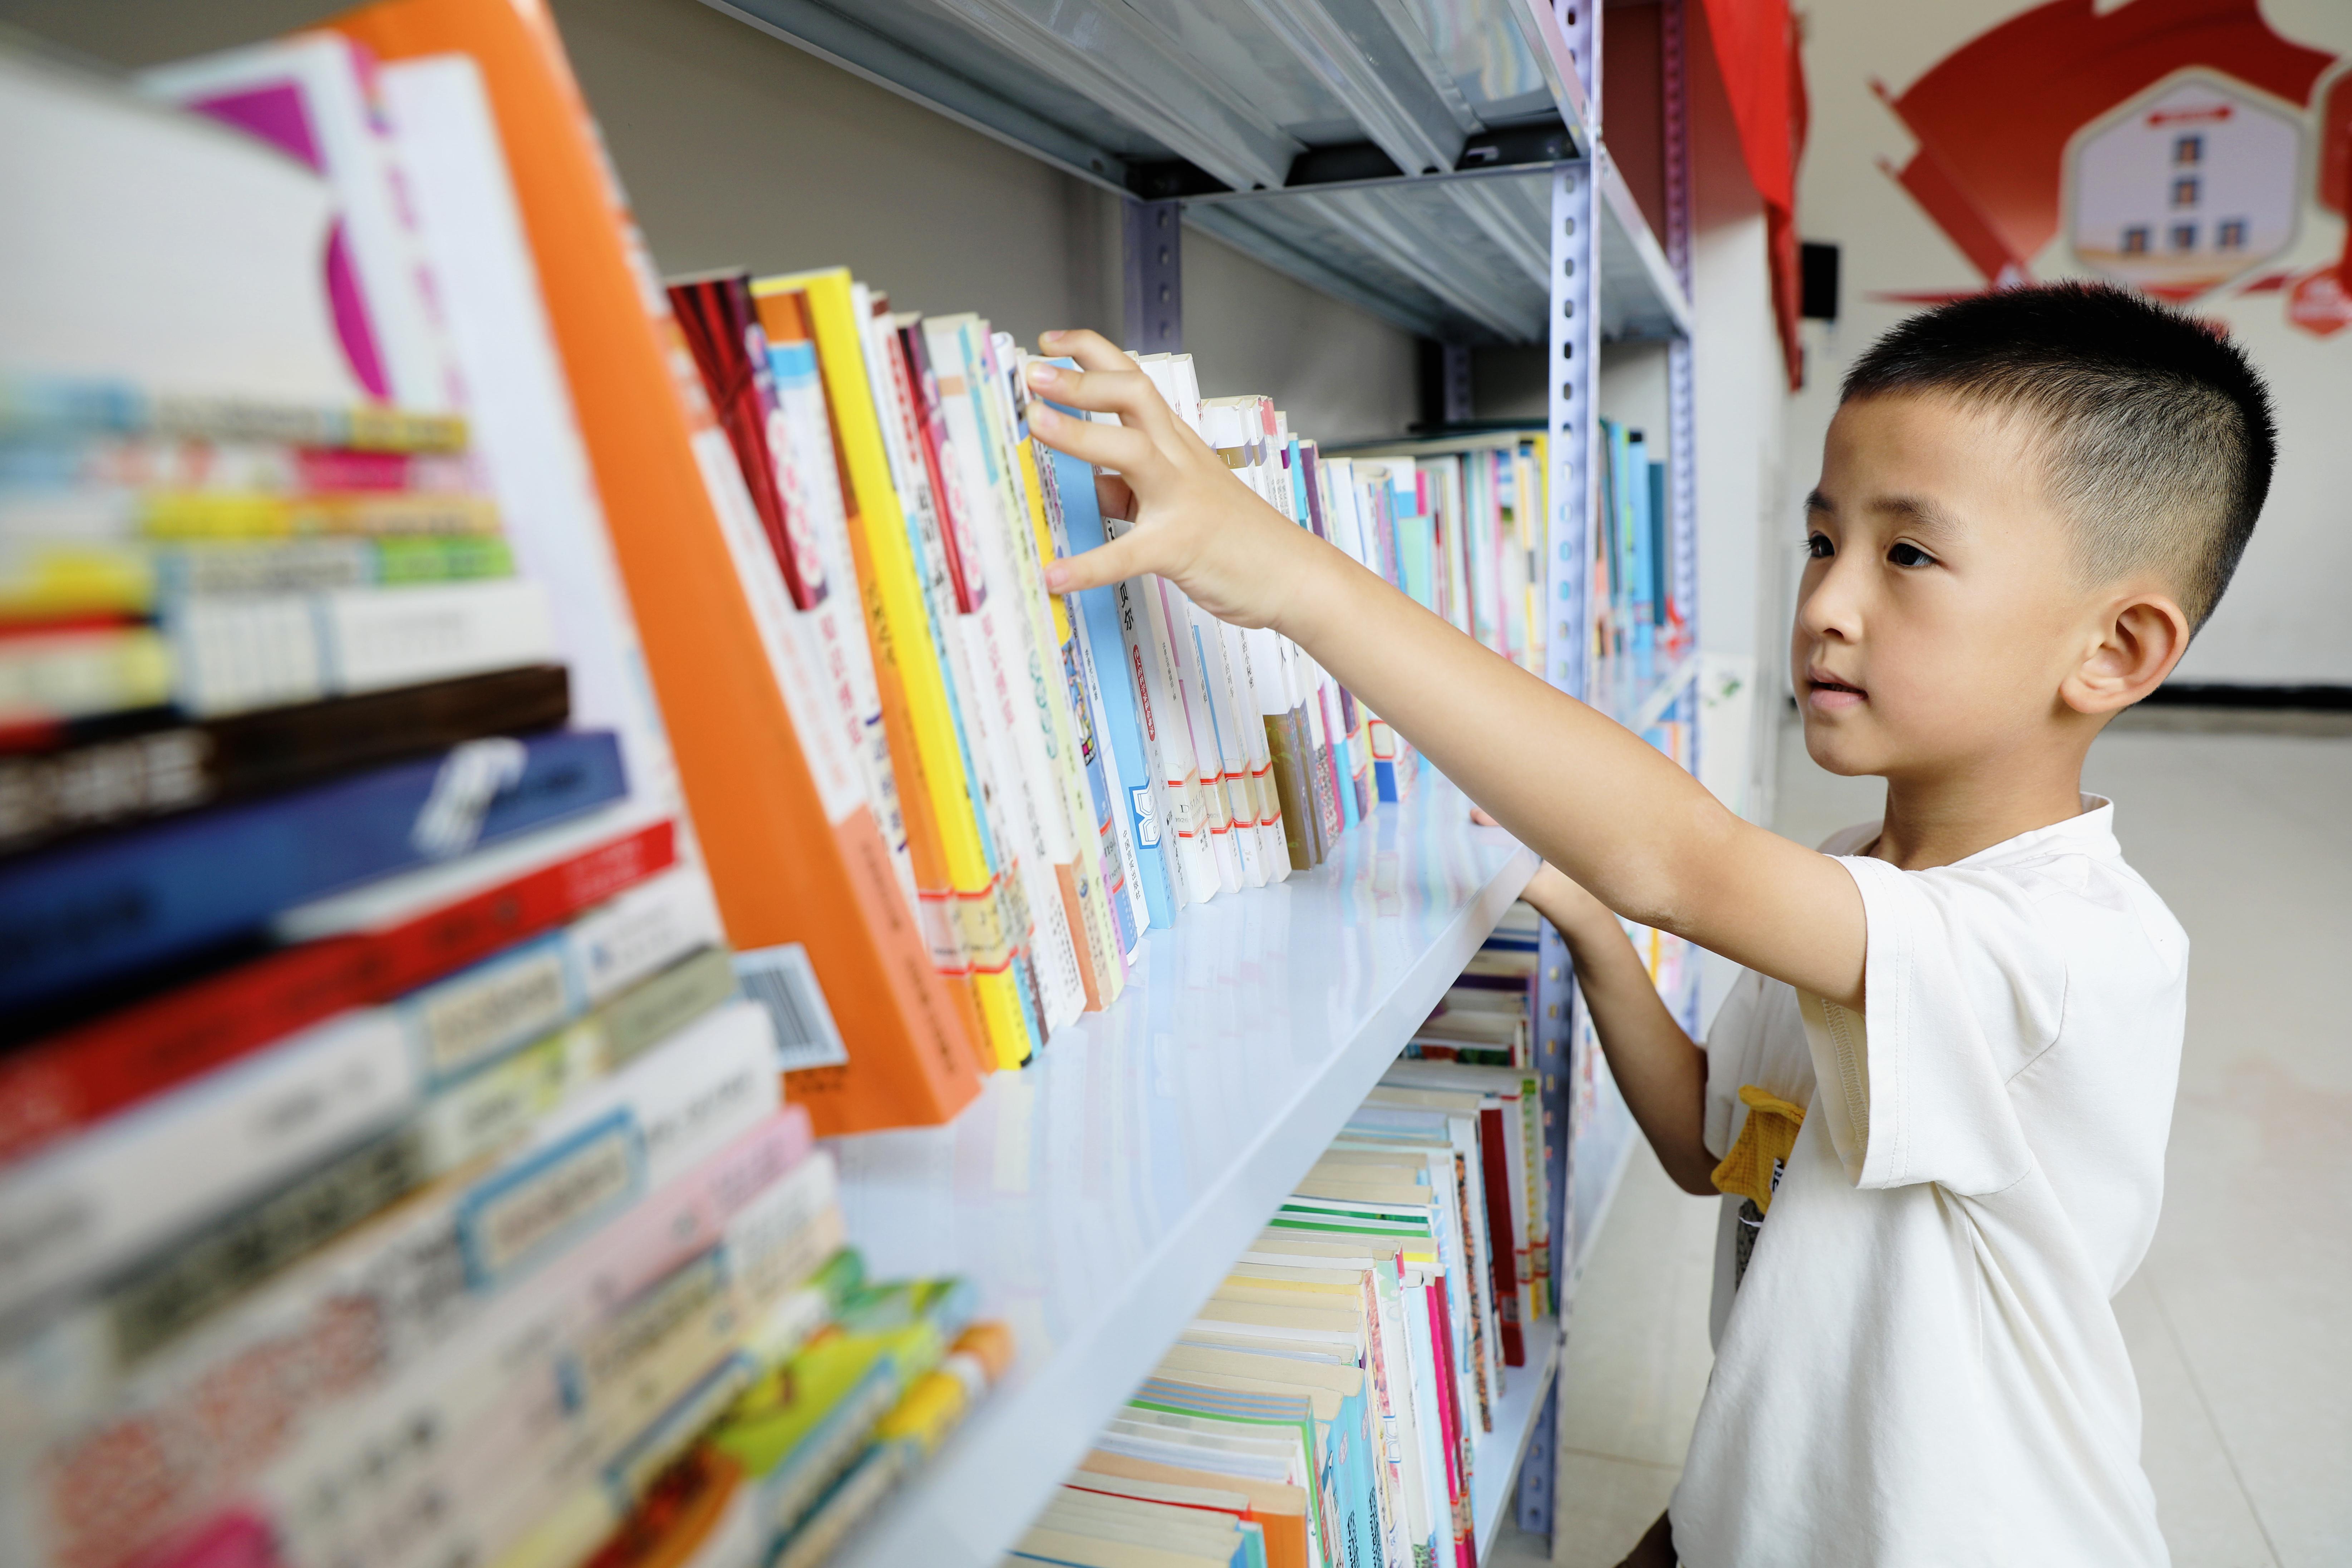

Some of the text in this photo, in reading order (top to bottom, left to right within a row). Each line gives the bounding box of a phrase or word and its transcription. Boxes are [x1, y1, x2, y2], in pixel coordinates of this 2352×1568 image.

[1120, 582, 1133, 631] 贝尔
[1240, 626, 1254, 689] 里的小秘密
[1122, 830, 1141, 901] 中国言实出版社
